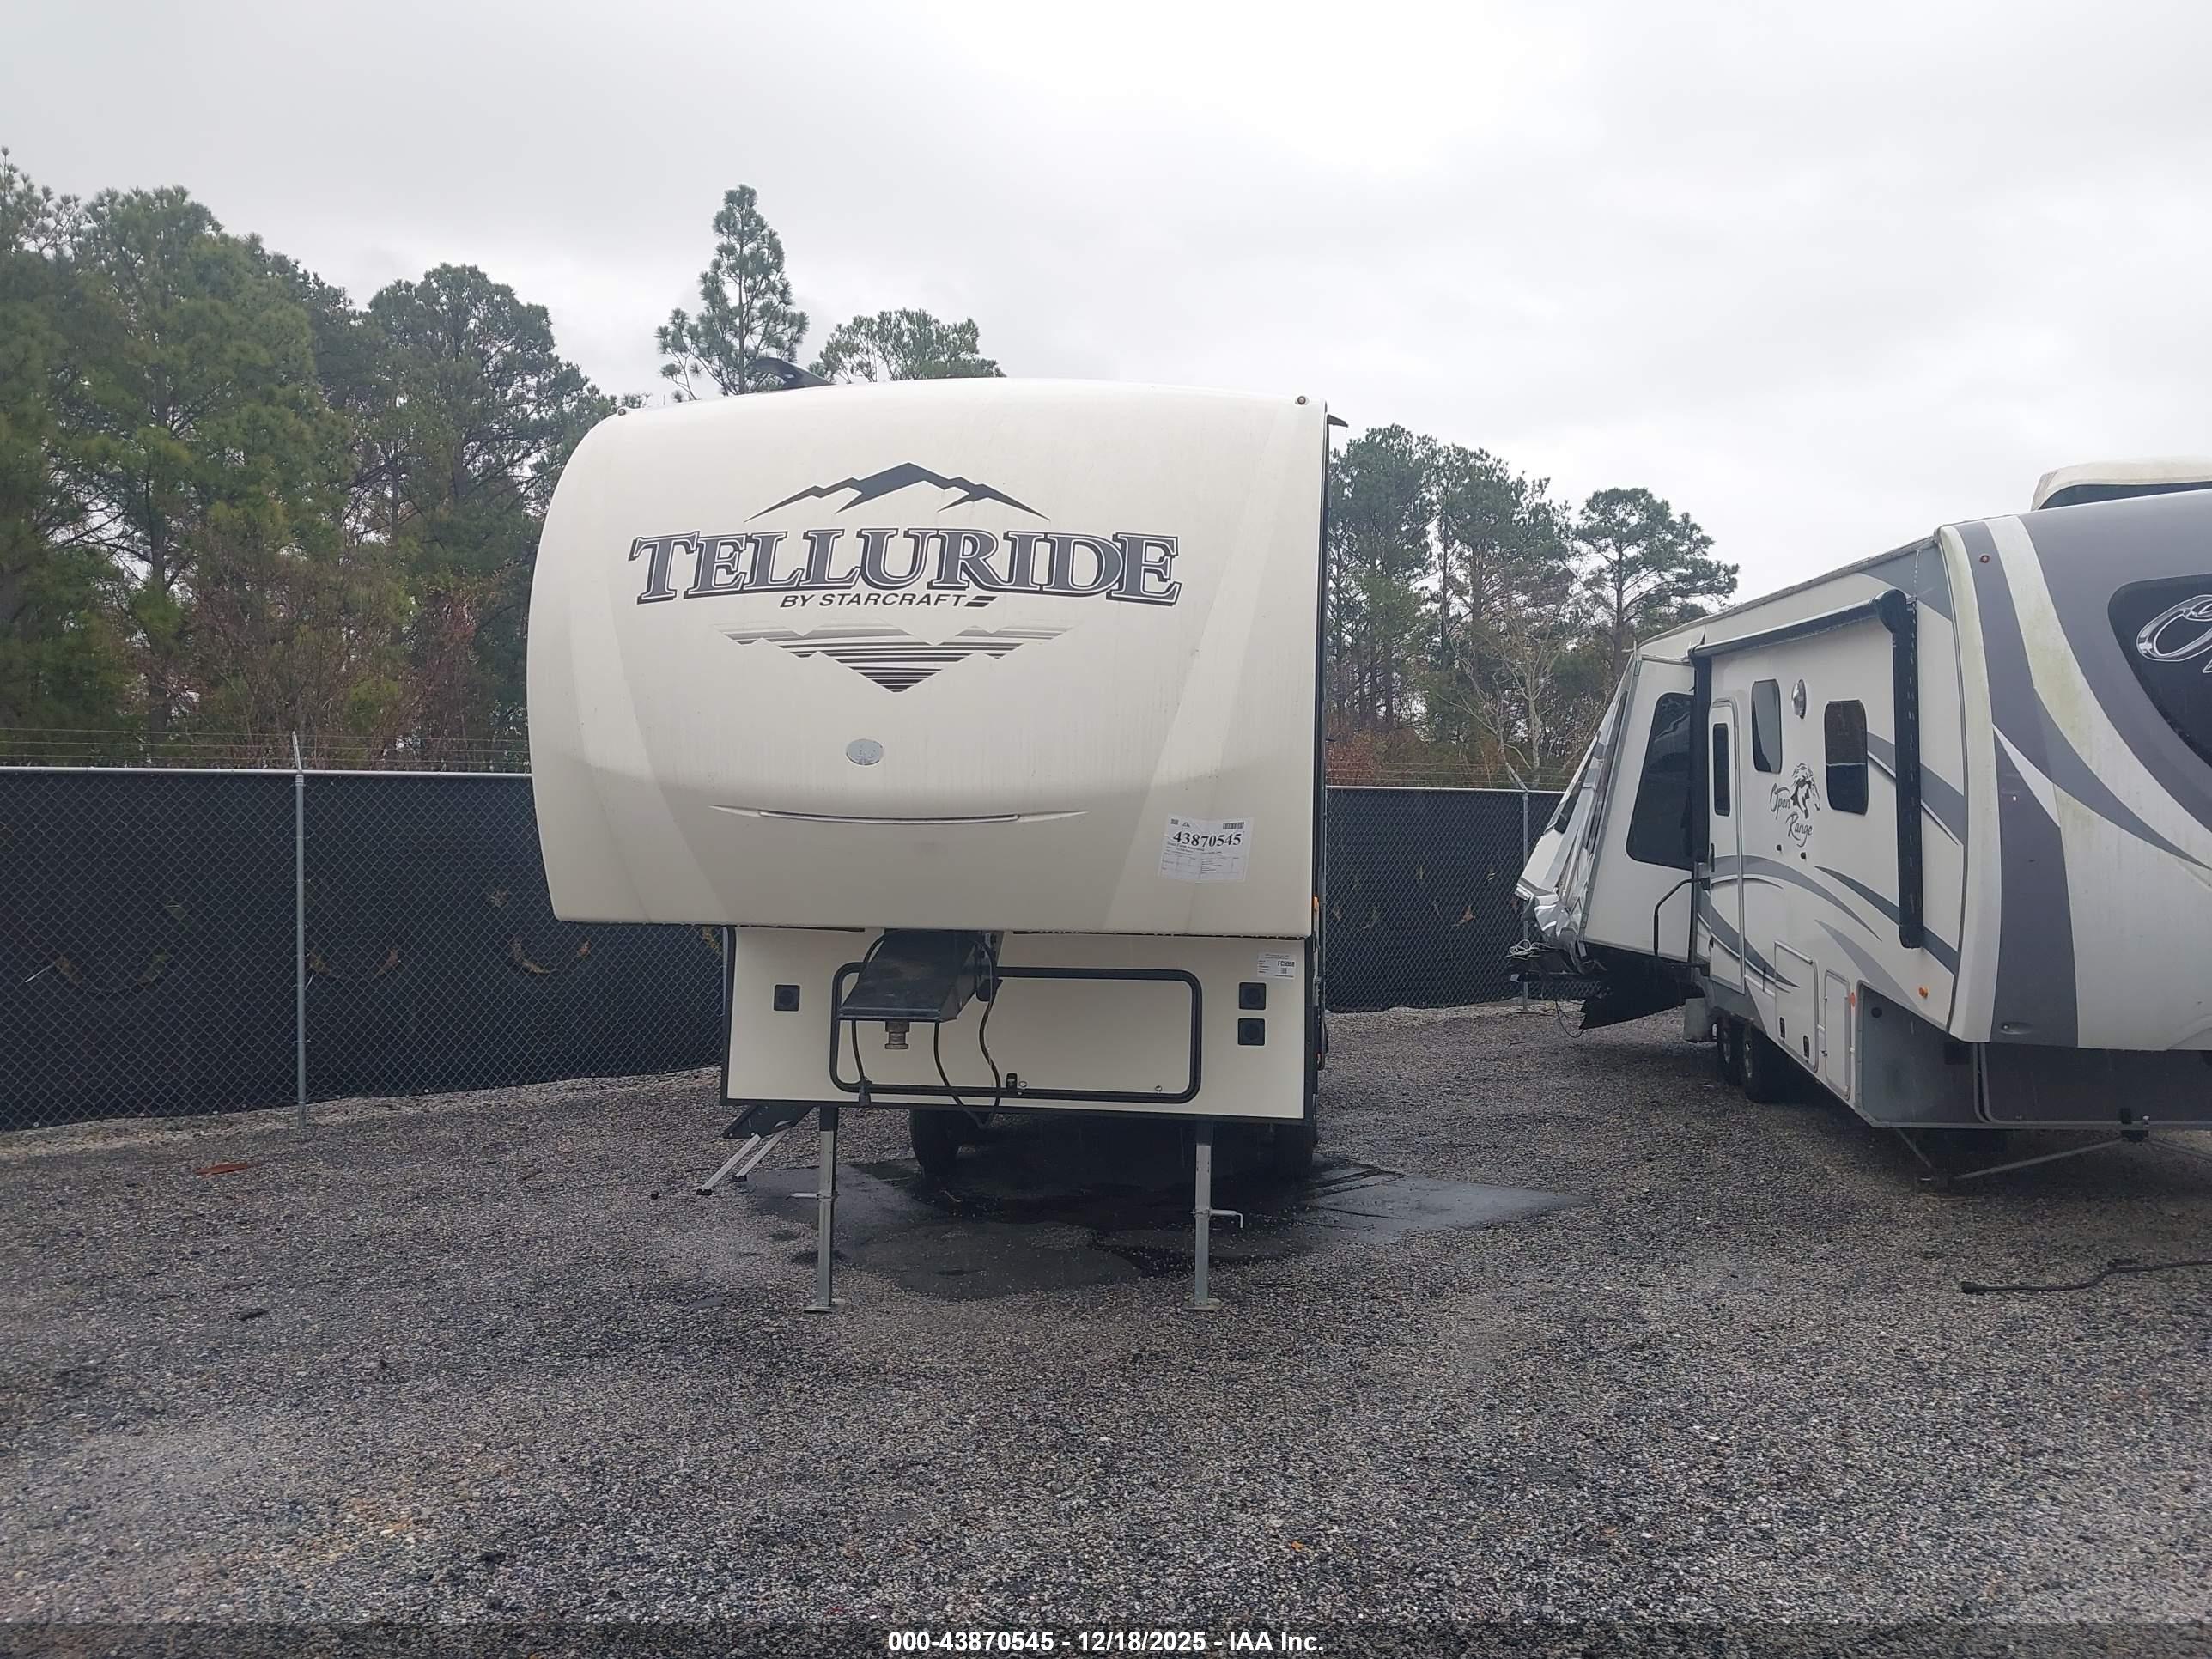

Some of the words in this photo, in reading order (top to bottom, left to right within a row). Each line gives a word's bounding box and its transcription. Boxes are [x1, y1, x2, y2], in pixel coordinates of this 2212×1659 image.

[629, 528, 1182, 606] TELLURIDE
[779, 594, 815, 608] BY
[818, 592, 968, 607] STARCRAFT
[1770, 783, 1791, 820] Open
[1173, 831, 1242, 848] 43870545
[1785, 811, 1813, 847] Range
